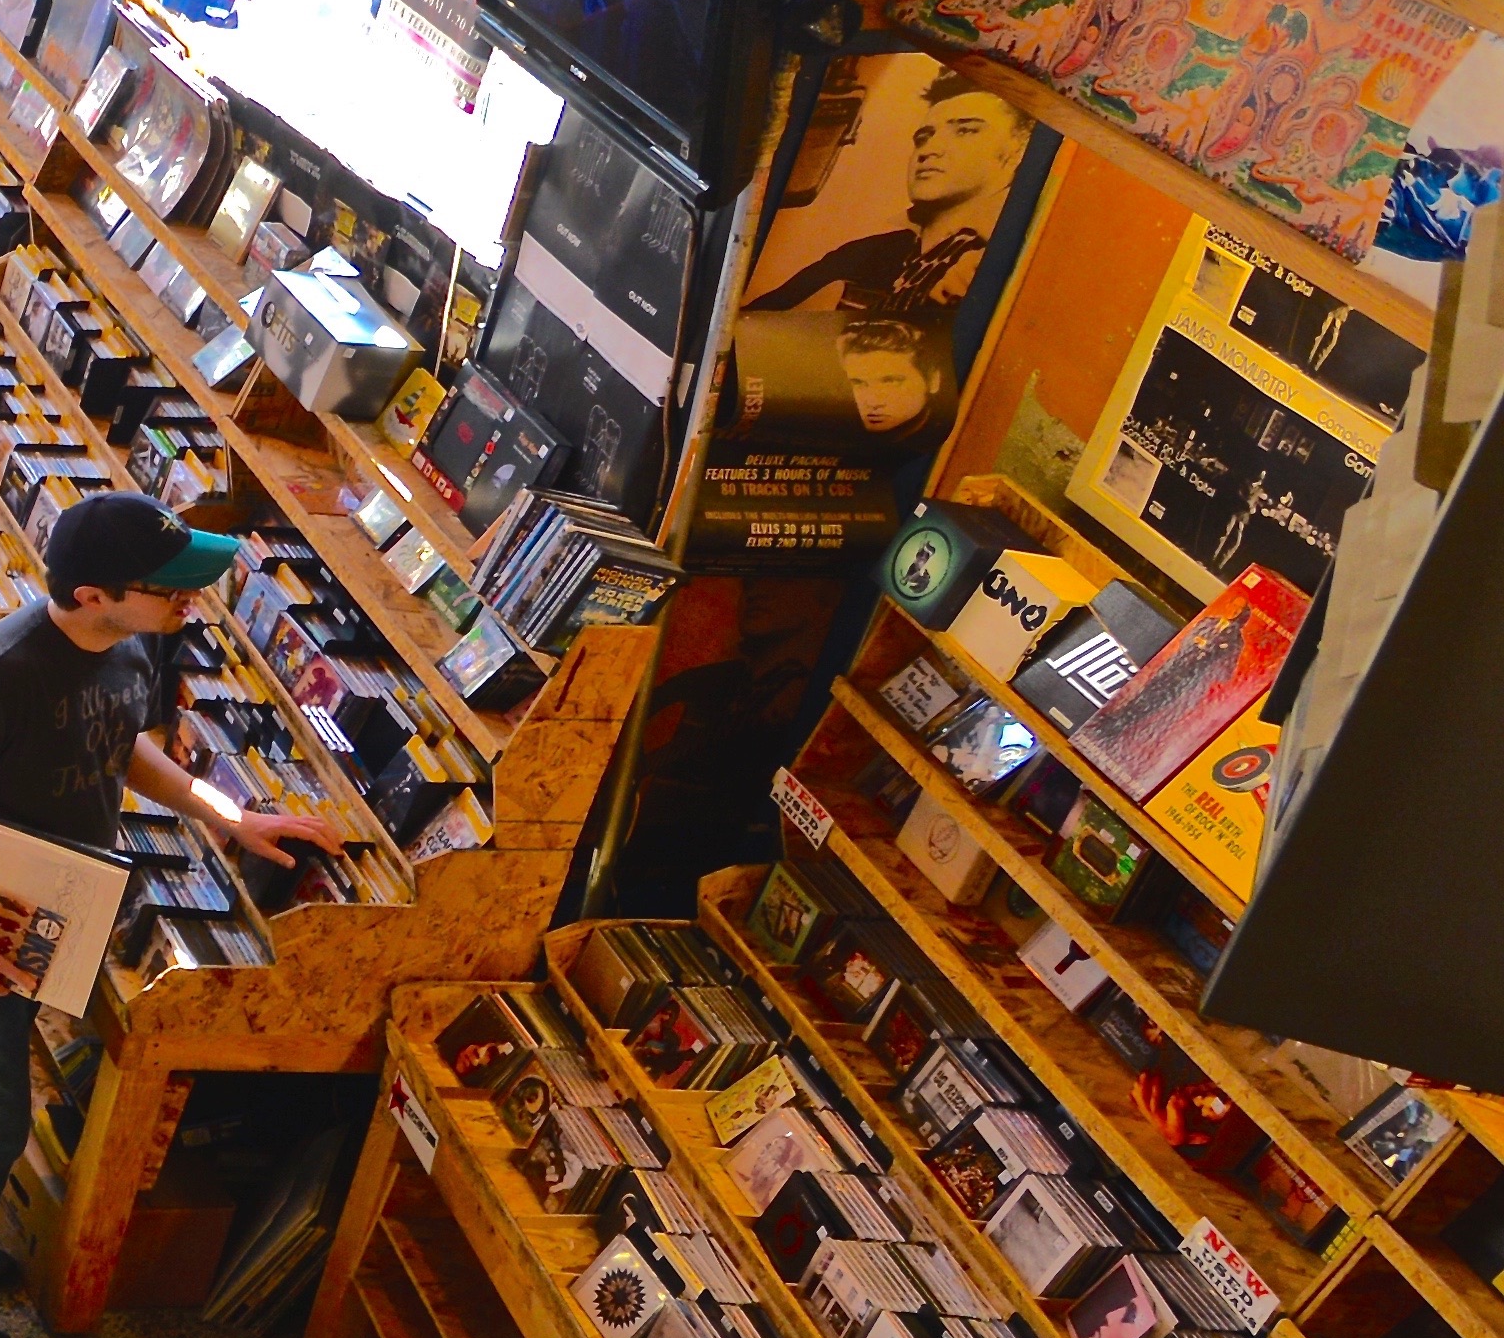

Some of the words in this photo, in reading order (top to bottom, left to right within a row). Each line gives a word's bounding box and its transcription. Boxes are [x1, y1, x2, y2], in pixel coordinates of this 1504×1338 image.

[1205, 228, 1247, 256] Compact
[1284, 270, 1314, 297] Digital
[1169, 311, 1219, 352] JAMES
[1219, 342, 1299, 404] MCMURTRY
[705, 467, 759, 481] FEATURES
[762, 468, 771, 480] 3
[773, 467, 812, 481] HOURS
[814, 468, 830, 480] OF
[834, 469, 873, 482] MUSIC
[744, 454, 786, 467] DELUXE
[1188, 471, 1219, 498] Digital
[720, 482, 737, 495] 80
[741, 482, 790, 496] TRACKS
[792, 483, 812, 496] ON
[816, 483, 825, 495] 3
[828, 483, 856, 496] CDS
[746, 537, 776, 548] ELVIS
[778, 537, 800, 548] 2ND
[801, 538, 817, 548] TO
[818, 537, 846, 549] NONE
[750, 522, 781, 535] ELVIS
[784, 522, 798, 535] 30
[800, 522, 815, 535] #1
[819, 523, 844, 536] HITS
[772, 792, 825, 849] ARRIVALS
[781, 769, 829, 825] NEW
[781, 788, 822, 832] USED
[1180, 782, 1197, 802] THE
[1194, 790, 1223, 821] REAL
[1219, 809, 1245, 842] BIRTH
[1179, 1243, 1262, 1334] ARRIVALS
[1197, 1247, 1257, 1307] USED
[1204, 1226, 1272, 1301] NEW
